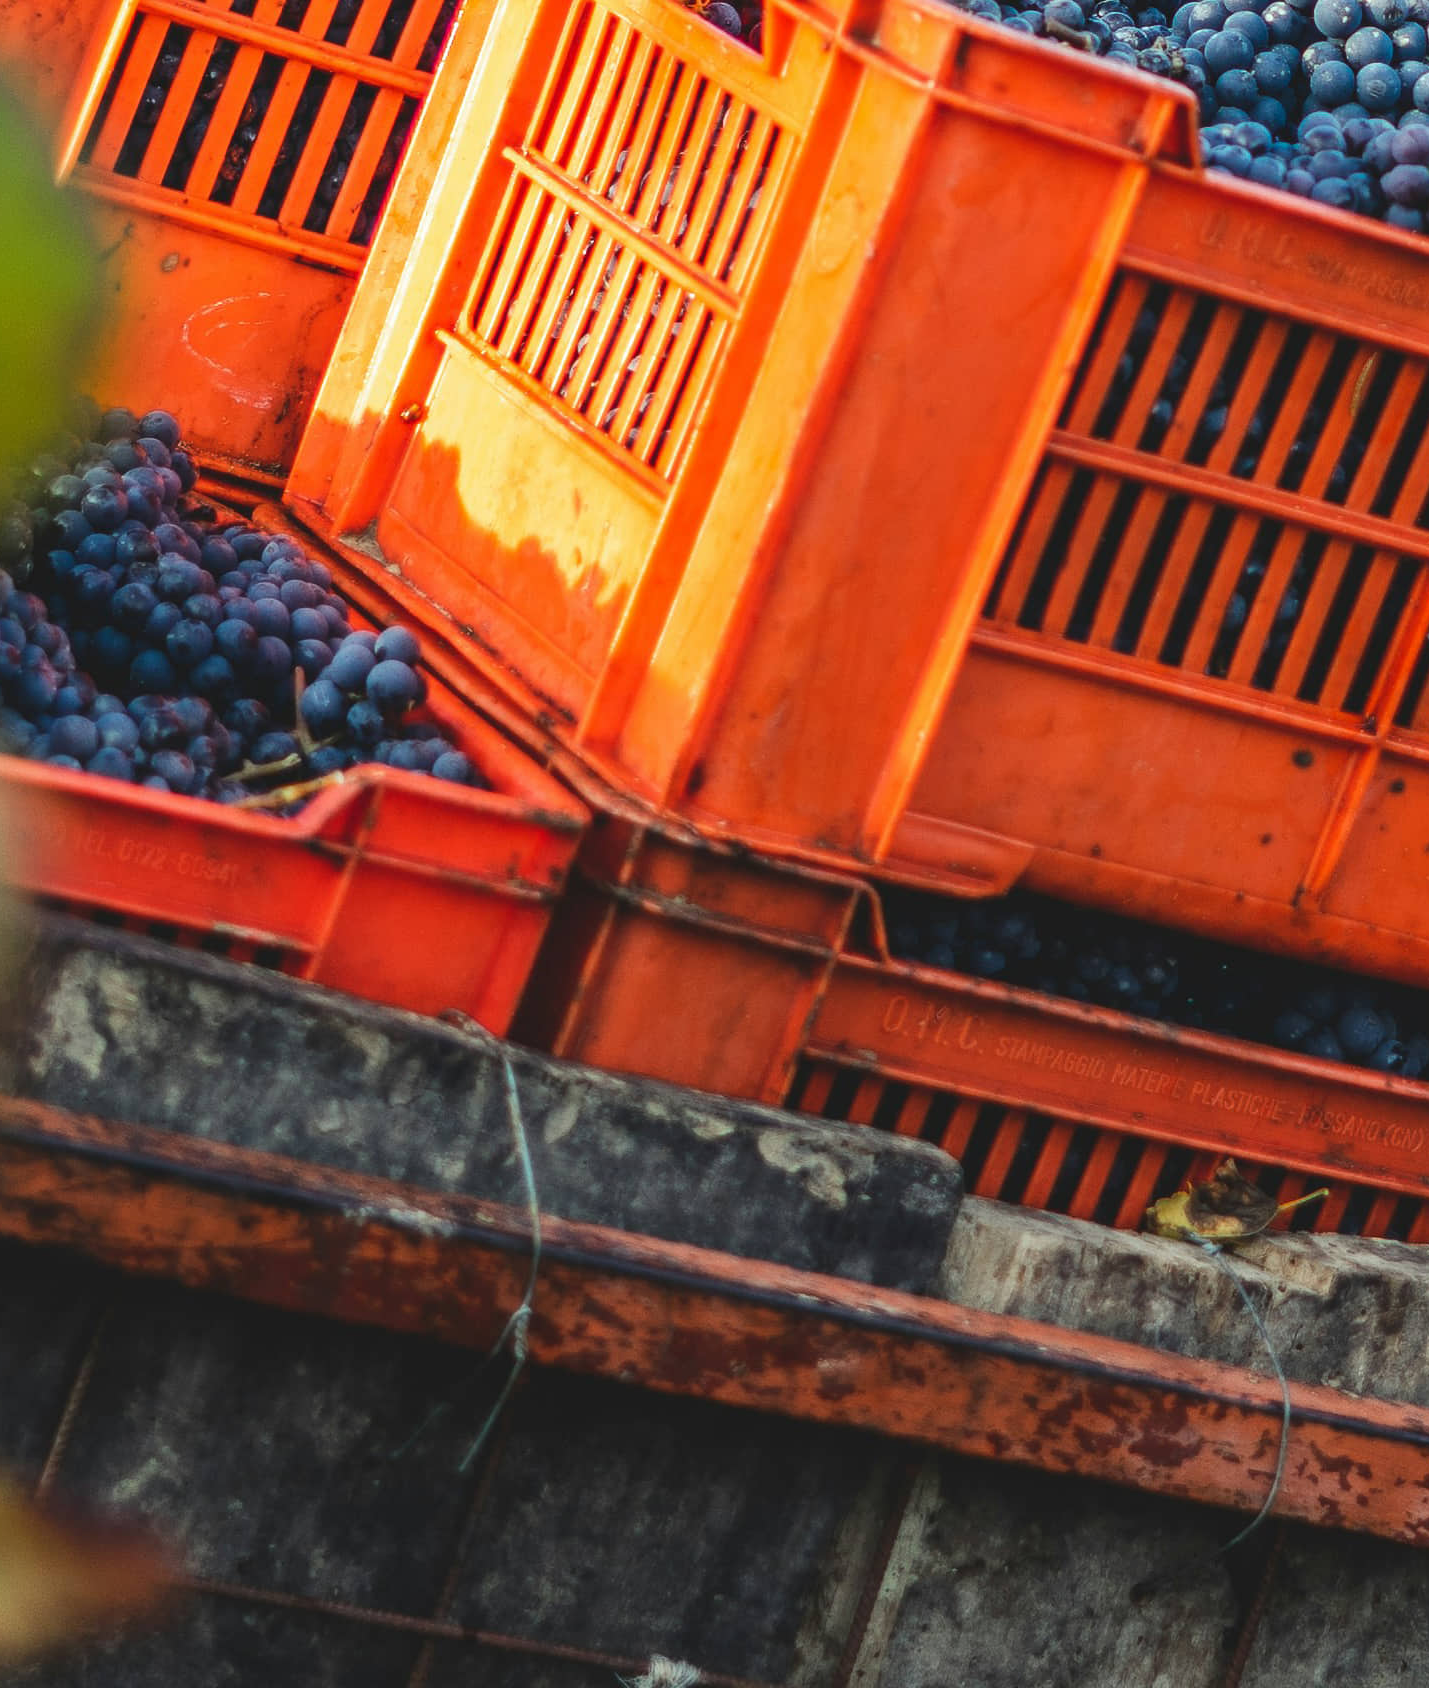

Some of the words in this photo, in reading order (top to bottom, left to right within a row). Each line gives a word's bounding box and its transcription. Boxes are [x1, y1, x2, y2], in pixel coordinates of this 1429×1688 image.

[994, 1035, 1106, 1080] STAMPAGGIO
[1110, 1063, 1187, 1100] MATERIE
[1382, 1122, 1425, 1154] (CN)
